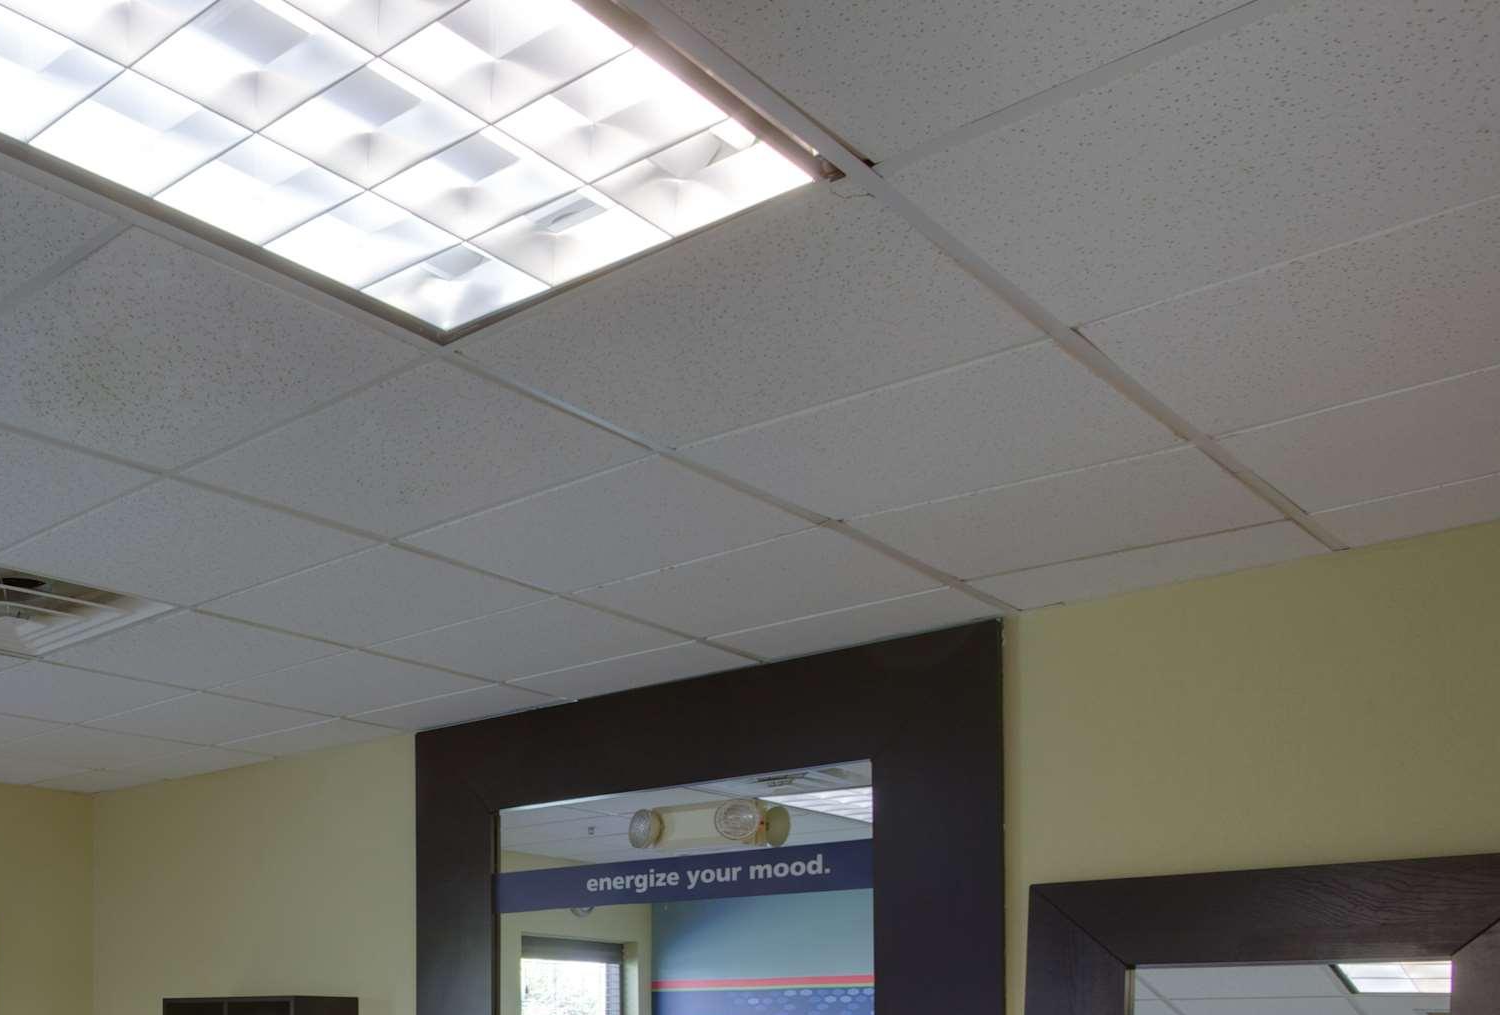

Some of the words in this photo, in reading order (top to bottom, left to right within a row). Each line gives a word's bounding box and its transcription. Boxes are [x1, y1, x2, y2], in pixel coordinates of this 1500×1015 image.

[586, 869, 680, 894] energize
[686, 864, 743, 890] your
[749, 854, 831, 881] mood.
